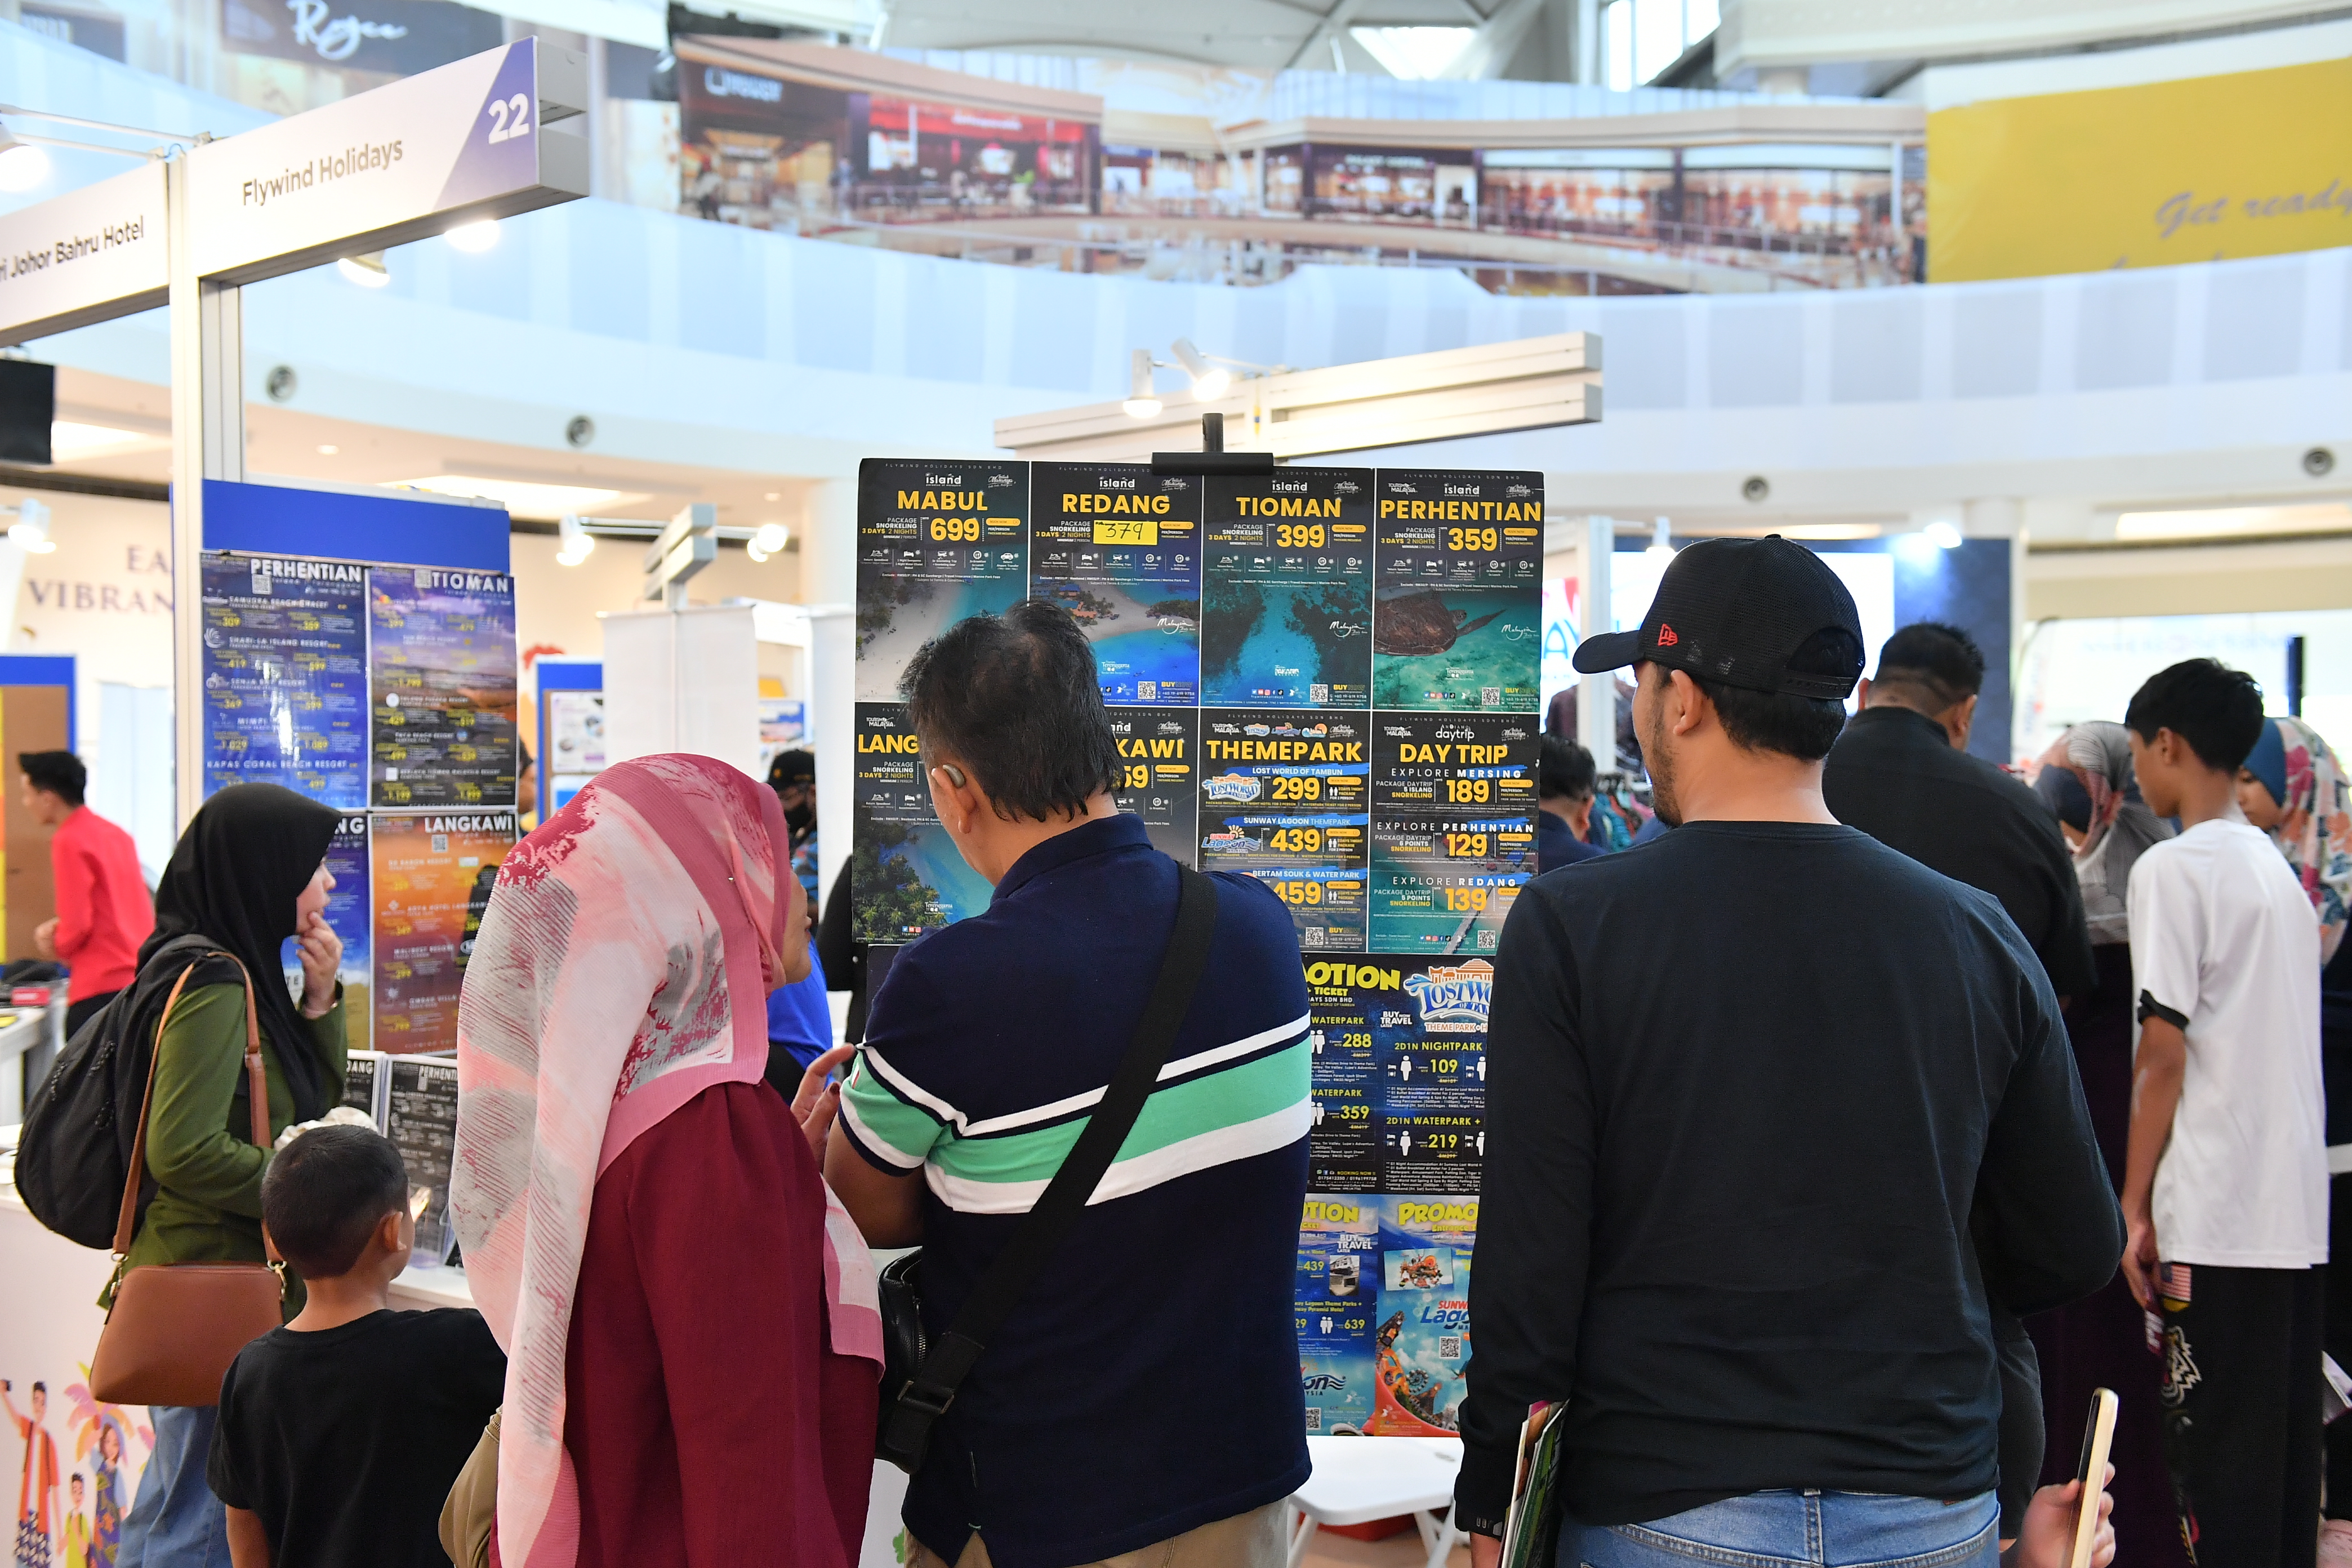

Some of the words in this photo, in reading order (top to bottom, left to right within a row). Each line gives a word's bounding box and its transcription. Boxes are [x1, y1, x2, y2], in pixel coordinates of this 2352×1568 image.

[487, 92, 529, 144] 22
[243, 162, 313, 207] Flywind
[319, 139, 403, 184] Holidays
[2154, 190, 2226, 239] Get
[11, 249, 52, 278] Johor
[56, 234, 99, 263] Bahru
[104, 215, 144, 250] Hotel
[926, 475, 961, 484] island
[1099, 479, 1135, 488] island
[1272, 482, 1308, 491] island
[1444, 485, 1479, 495] island
[898, 491, 988, 511] MABUL
[1063, 493, 1170, 514] REDANG
[1236, 497, 1342, 517] TIOMAN
[1380, 500, 1541, 521] PERHENTIAN
[930, 518, 980, 541] 699
[1105, 523, 1143, 540] 379
[1276, 524, 1325, 547] 399
[1448, 527, 1497, 551] 359
[127, 546, 170, 573] EA
[251, 559, 362, 582] PERHENTIAN
[432, 572, 508, 593] TIOMAN
[858, 734, 920, 754] LANG
[1435, 729, 1475, 741] daytrip
[1116, 739, 1184, 758] KAWI
[1206, 740, 1362, 761] THEMEPARK
[1400, 744, 1451, 763] DAY
[1456, 745, 1508, 764] TRIP
[1119, 765, 1149, 789] 59
[1391, 768, 1449, 777] EXPLORE
[1457, 769, 1521, 778] MERSING
[1272, 777, 1320, 800] 299
[1446, 779, 1489, 803] 189
[425, 816, 513, 833] LANGKAWI
[1443, 823, 1533, 832] PERHENTIAN
[1202, 837, 1245, 851] Lagoon
[1271, 829, 1320, 852] 439
[1447, 834, 1487, 856] 129
[1393, 877, 1450, 885] EXPLORE
[1459, 877, 1516, 887] REDANG
[1274, 882, 1321, 905] 459
[1445, 888, 1487, 911] 139
[1302, 961, 1401, 991] OTION
[1315, 987, 1348, 996] TICKET
[1343, 1034, 1371, 1048] 288
[1422, 1042, 1482, 1051] NIGHTPARK
[1431, 1059, 1458, 1073] 109
[1340, 1106, 1369, 1119] 359
[1428, 1134, 1457, 1148] 219
[1303, 1202, 1359, 1223] TION
[1398, 1202, 1478, 1225] PROMO
[1337, 1241, 1373, 1249] TRAVEL
[1303, 1261, 1324, 1271] 439
[1344, 1319, 1365, 1329] 639
